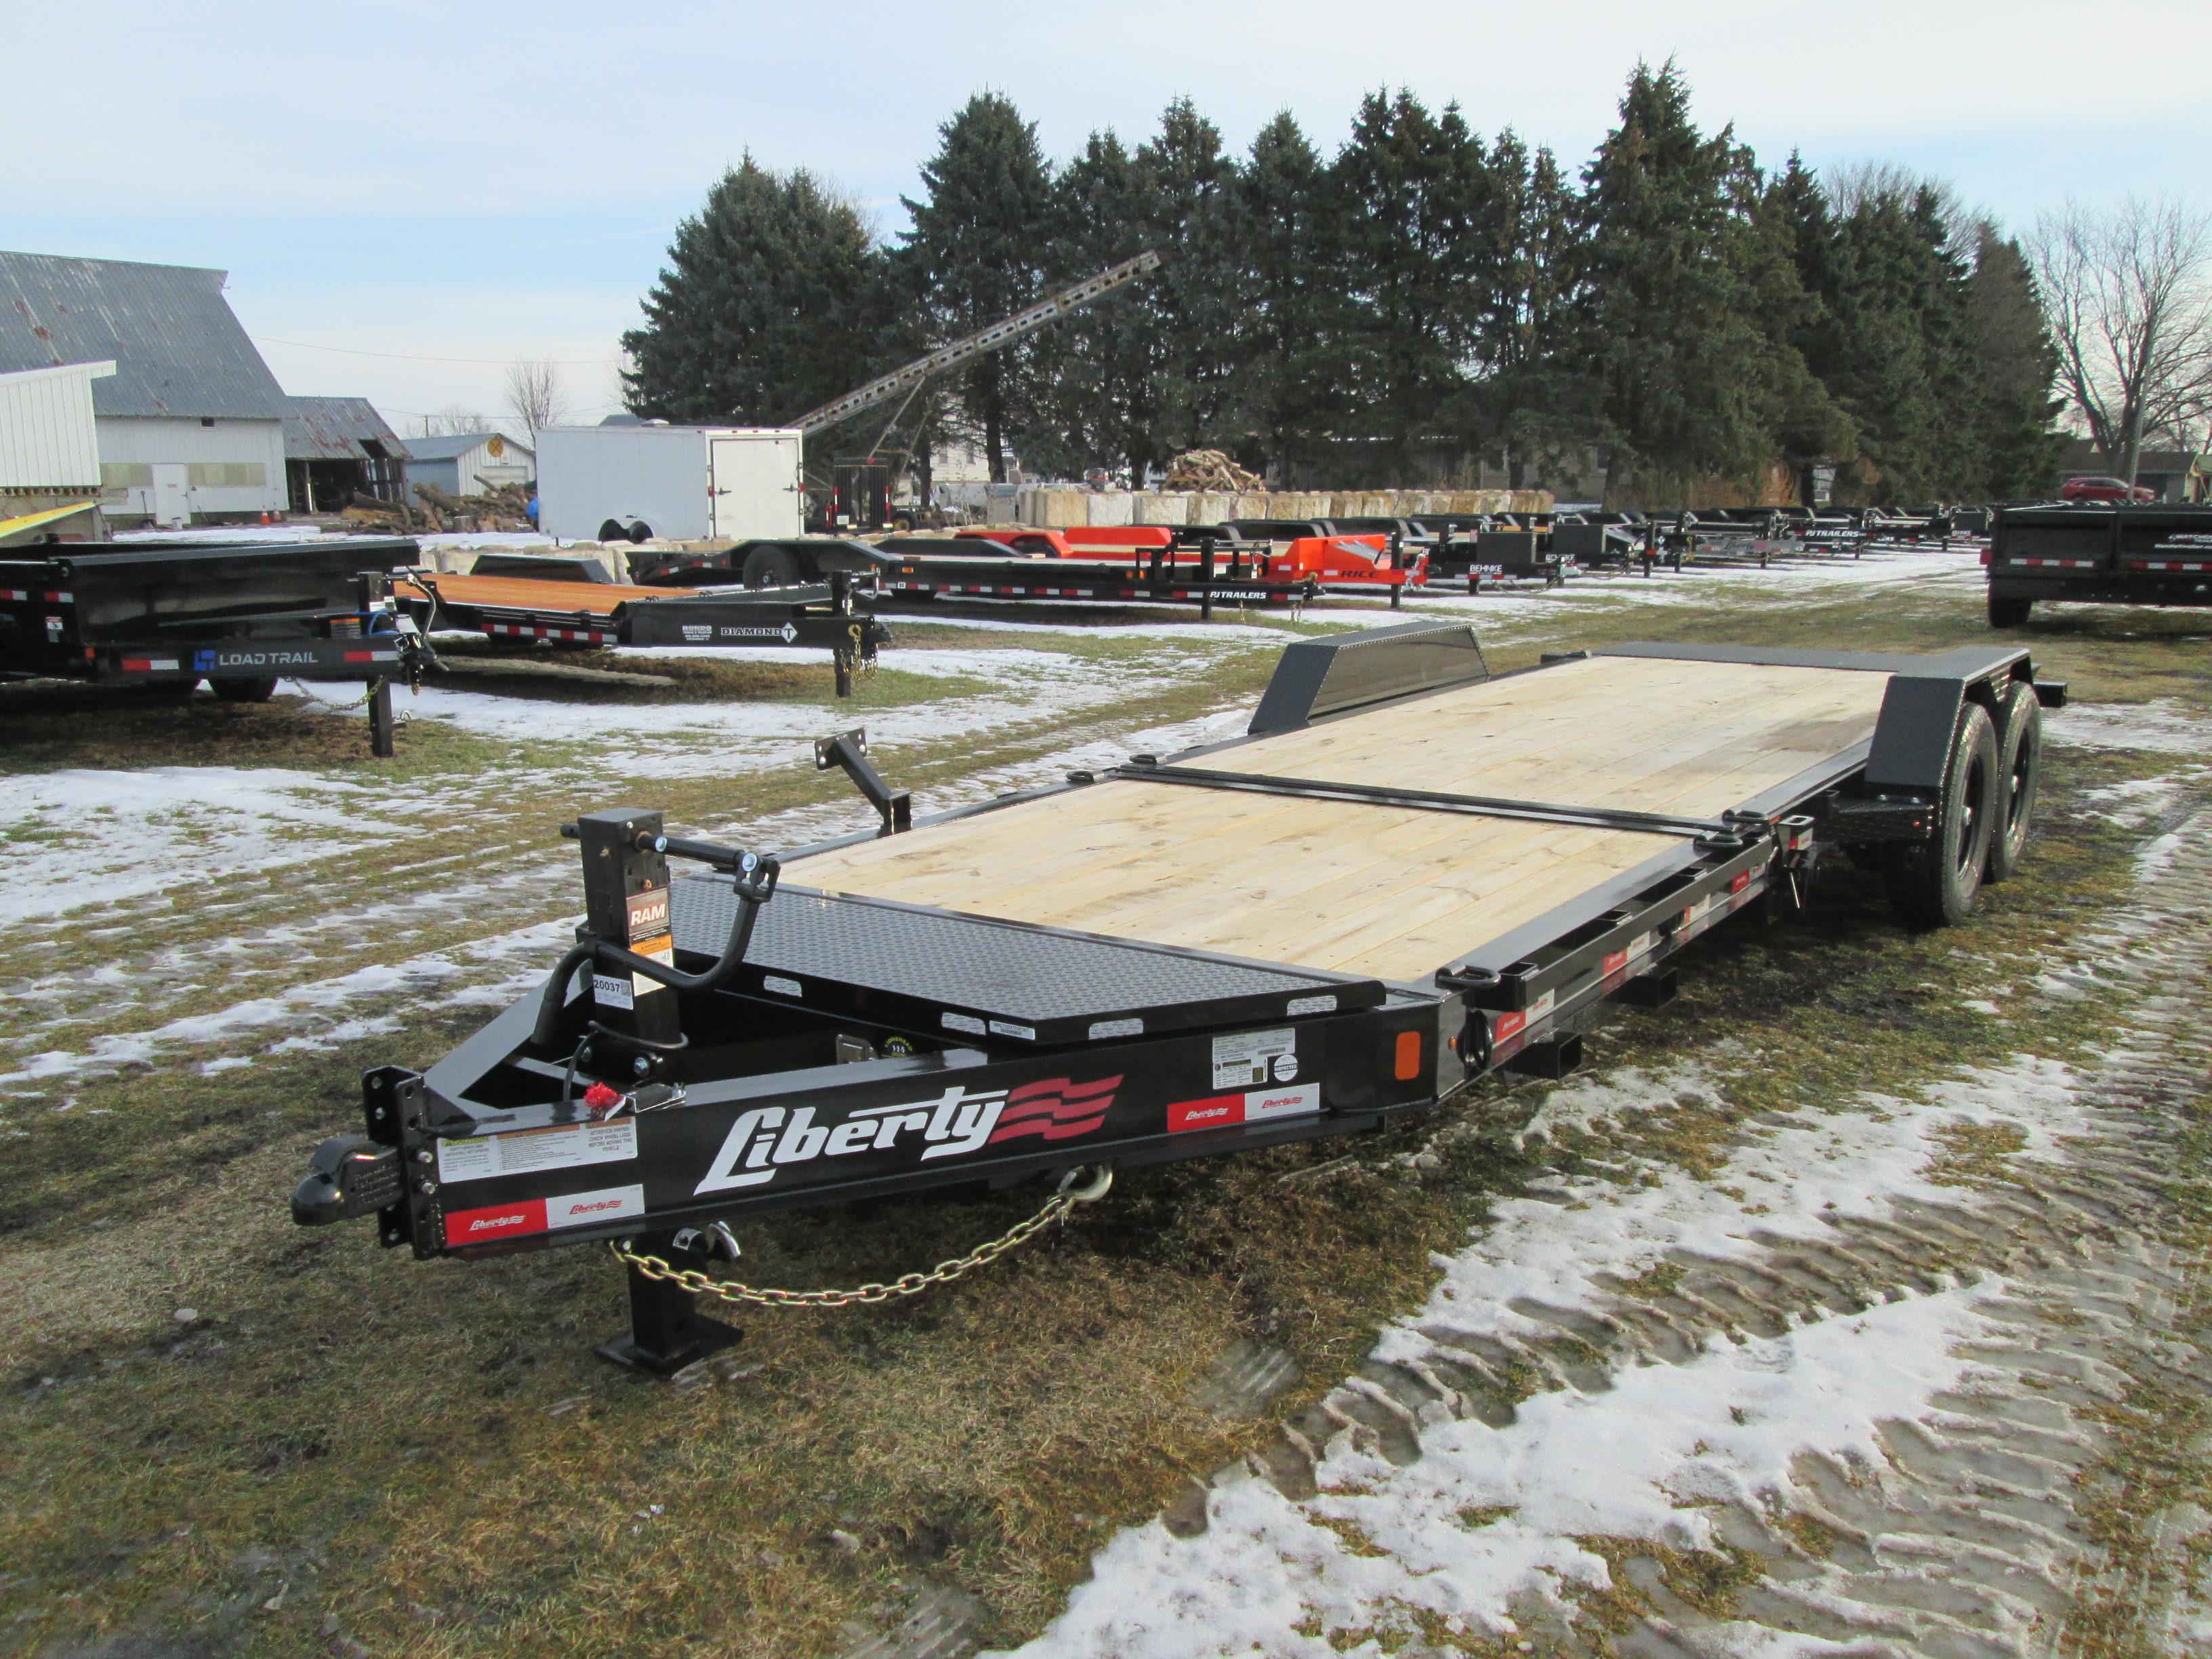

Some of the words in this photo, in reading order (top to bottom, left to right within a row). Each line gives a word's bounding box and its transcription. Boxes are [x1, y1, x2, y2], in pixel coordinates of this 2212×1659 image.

[1340, 570, 1380, 578] RICE
[721, 627, 781, 636] DIAMOND
[219, 653, 266, 665] LOAD
[268, 652, 319, 664] TRAIL
[631, 903, 665, 926] RAM
[594, 979, 620, 993] 20037
[884, 1037, 914, 1052] LIONSHEAD
[892, 1044, 905, 1053] 1-2-5
[1261, 1097, 1292, 1109] Liberty
[1185, 1108, 1216, 1121] Liberty
[693, 1086, 1009, 1196] Liberty
[568, 1201, 607, 1215] Liberty
[469, 1216, 508, 1231] Liberty
